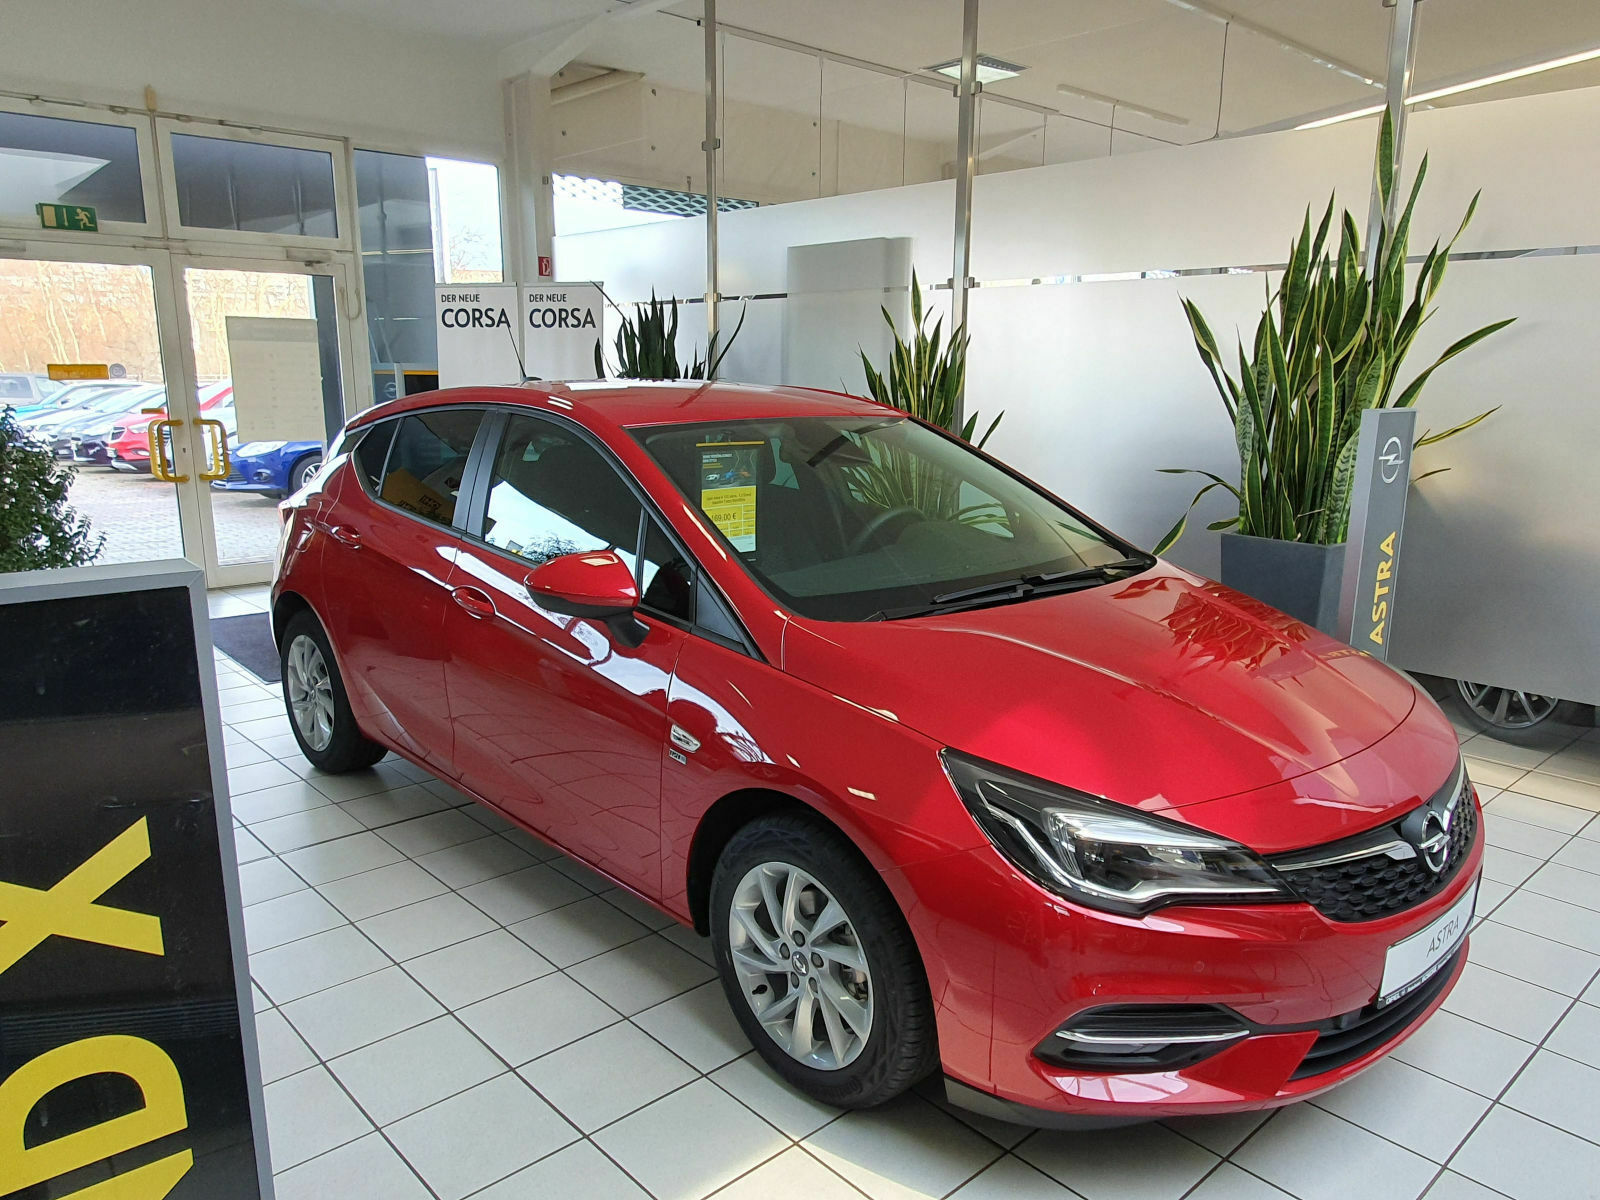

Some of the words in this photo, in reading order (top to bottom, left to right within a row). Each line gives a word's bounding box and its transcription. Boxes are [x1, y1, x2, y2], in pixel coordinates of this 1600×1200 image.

[441, 294, 457, 303] DER
[458, 294, 481, 303] NEUE
[529, 294, 546, 303] DER
[547, 294, 568, 303] NEUE
[441, 308, 511, 328] CORSA
[529, 308, 597, 328] CORSA
[732, 512, 737, 520] €
[1369, 531, 1397, 645] ASTRA
[1426, 915, 1459, 958] ASTRA
